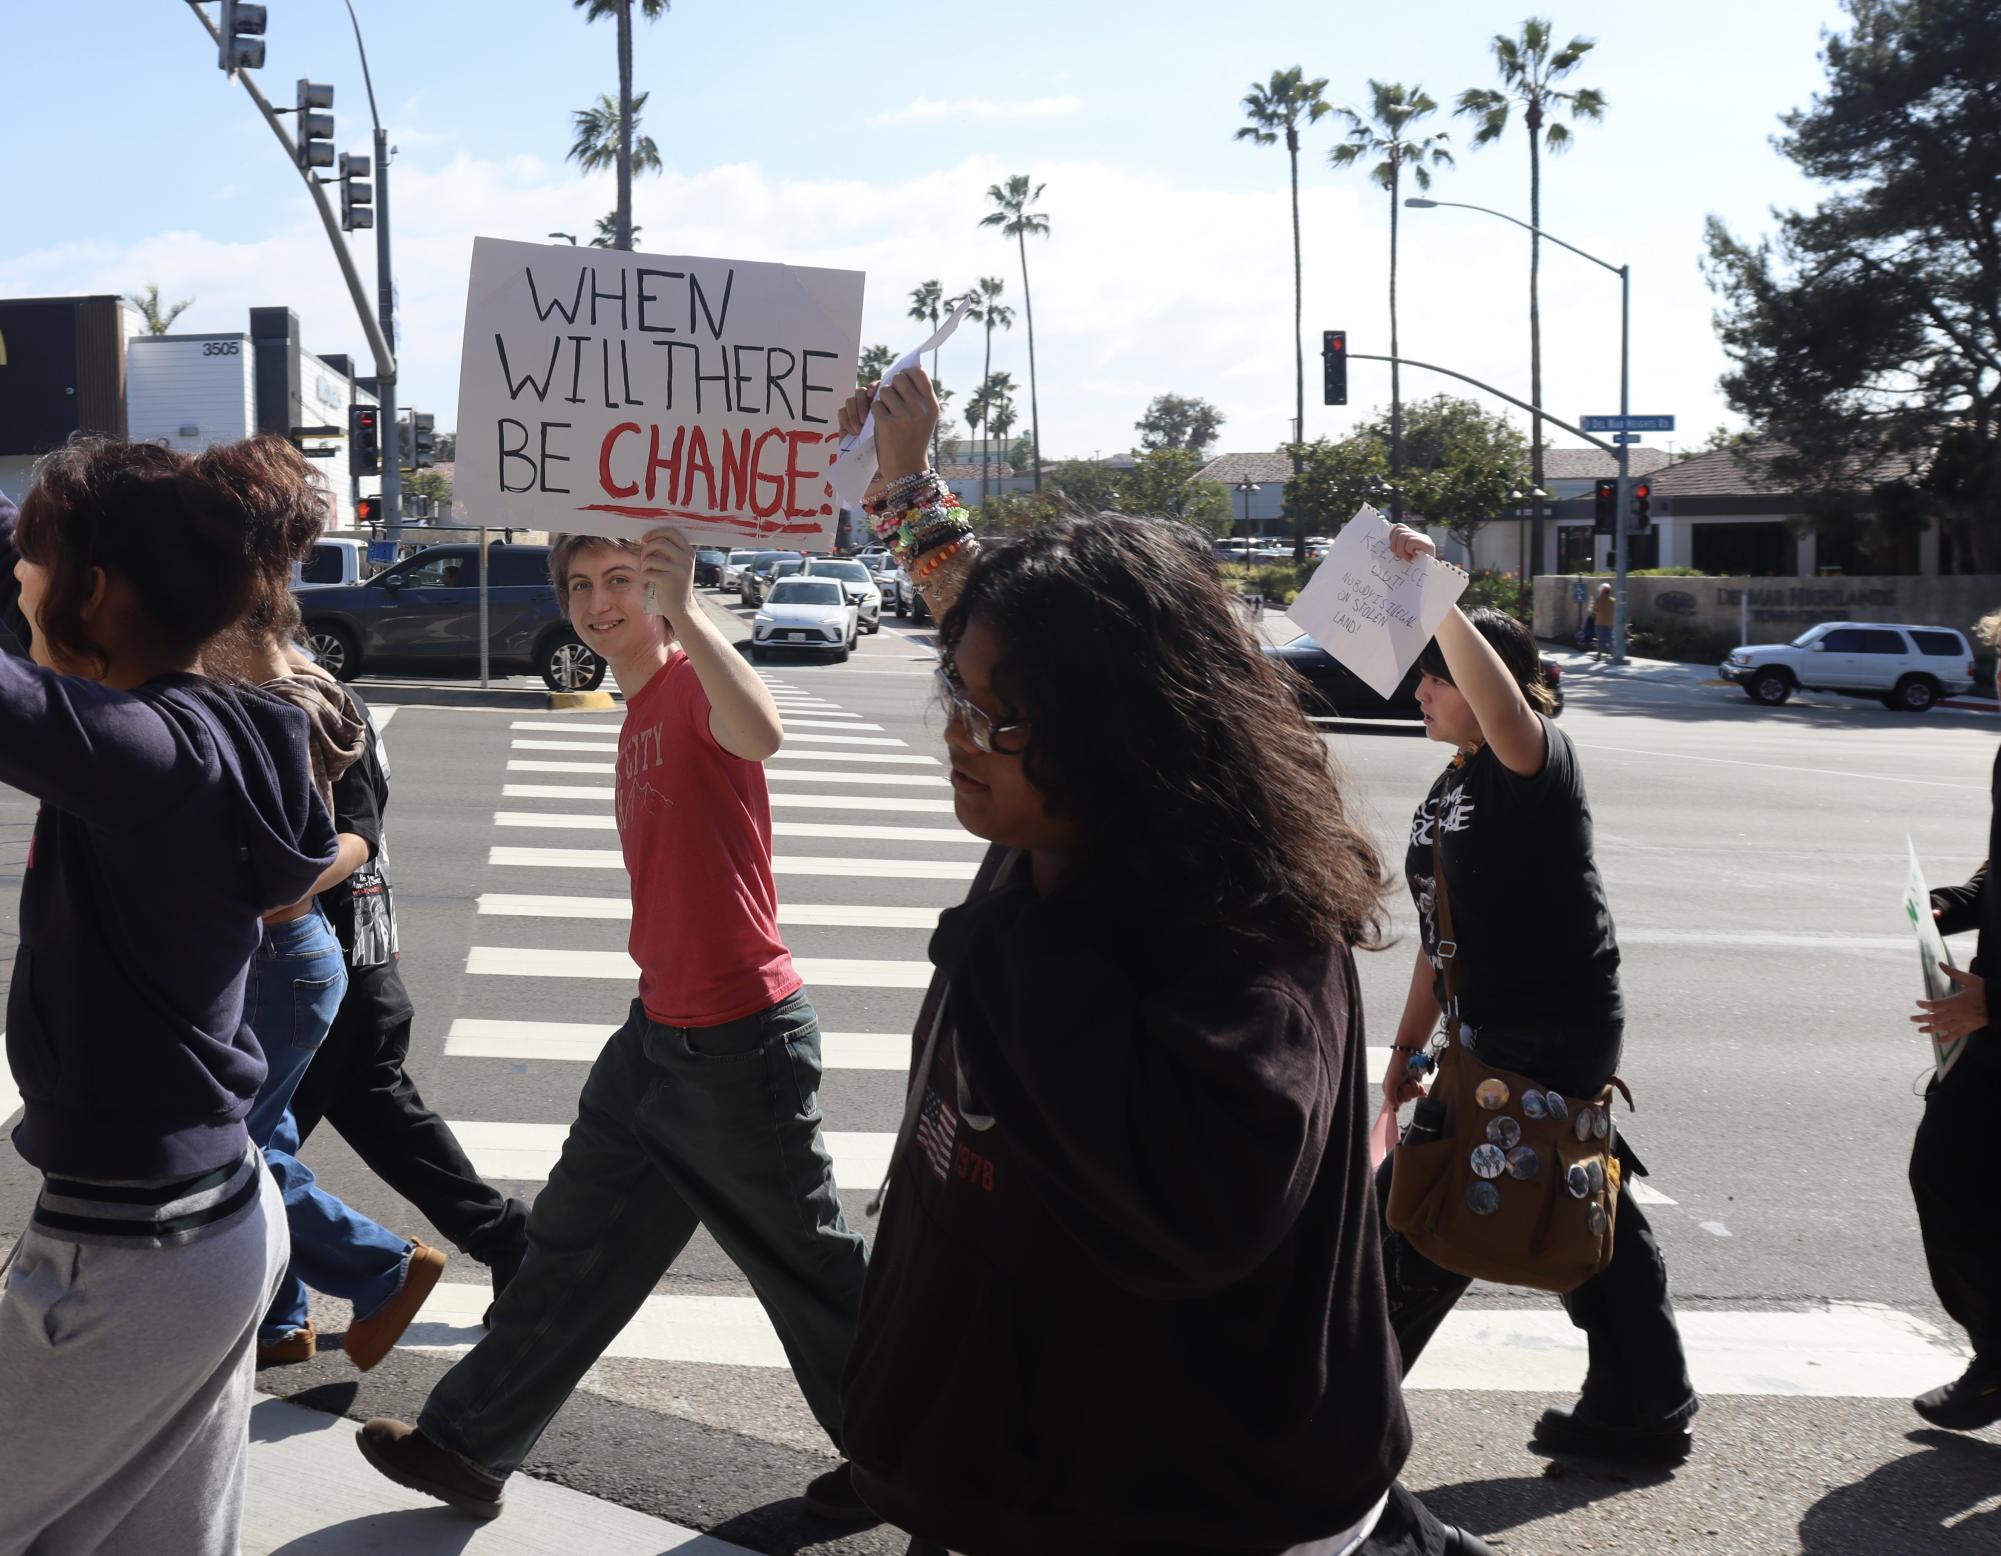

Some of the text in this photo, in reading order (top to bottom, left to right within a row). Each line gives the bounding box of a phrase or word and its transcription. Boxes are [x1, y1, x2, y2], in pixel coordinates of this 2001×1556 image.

[525, 266, 734, 340] WHEN
[202, 342, 239, 356] 3505
[495, 333, 839, 424] WILL THERE
[497, 418, 572, 494] BE
[1337, 591, 1388, 627] ON STOLEN
[1342, 571, 1376, 600] NOBODY
